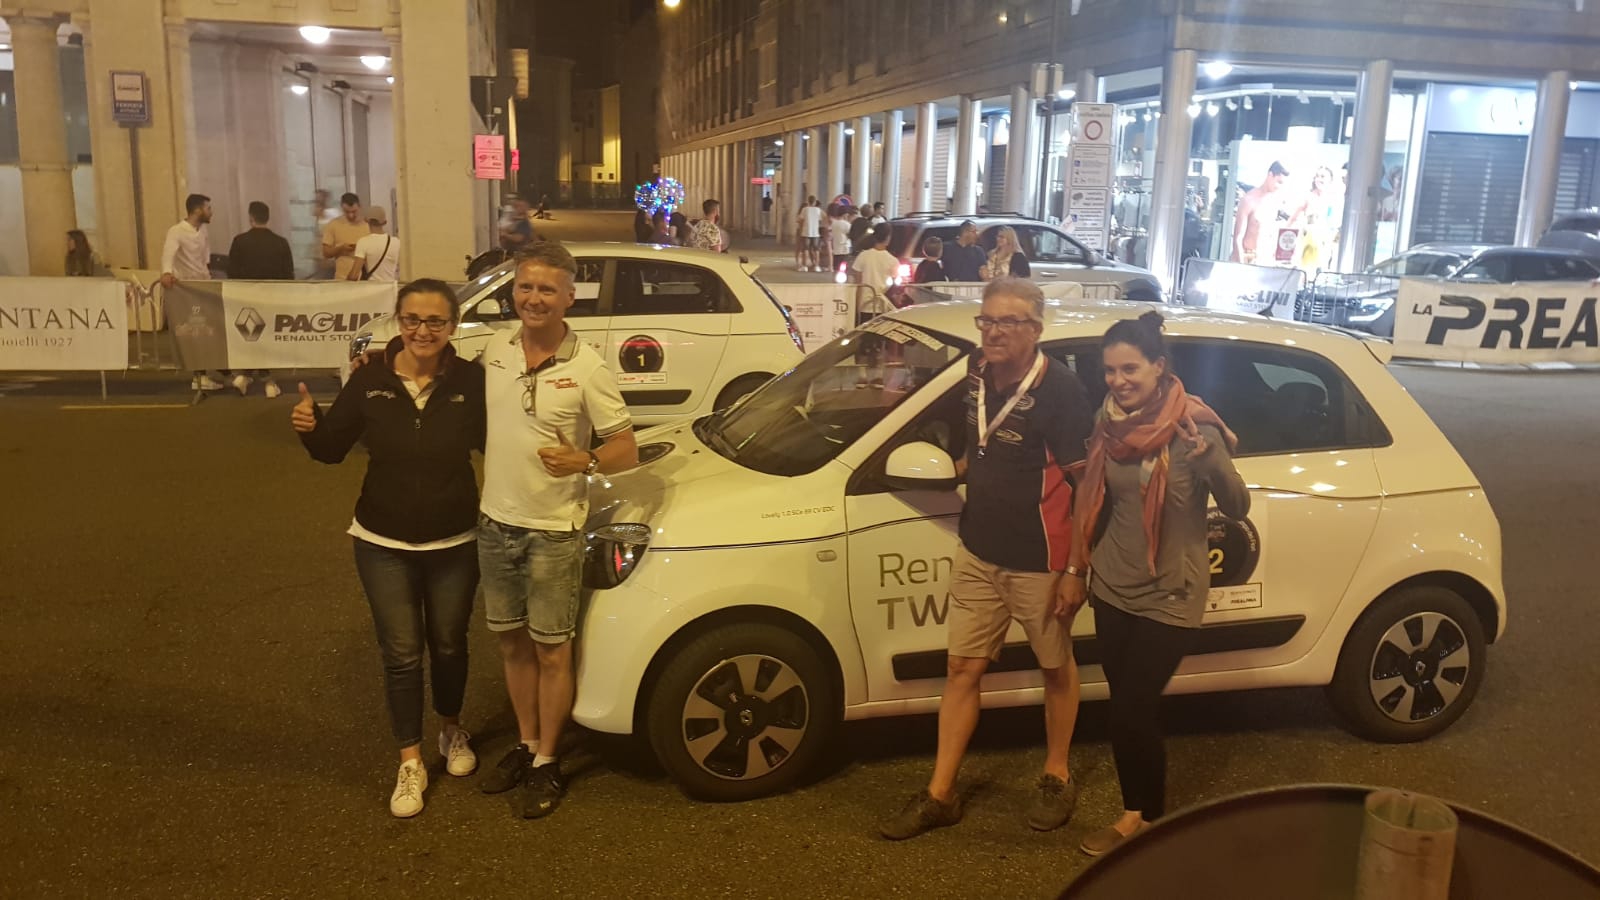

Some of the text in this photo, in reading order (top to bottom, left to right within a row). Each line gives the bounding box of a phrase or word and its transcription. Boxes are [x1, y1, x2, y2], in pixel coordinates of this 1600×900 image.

[1412, 294, 1599, 350] LA PREA
[44, 337, 73, 347] 1927
[274, 334, 353, 342] RENAULT STO
[637, 353, 645, 367] 1
[877, 552, 954, 588] Ren
[1208, 548, 1225, 574] 2
[877, 592, 951, 630] TW
